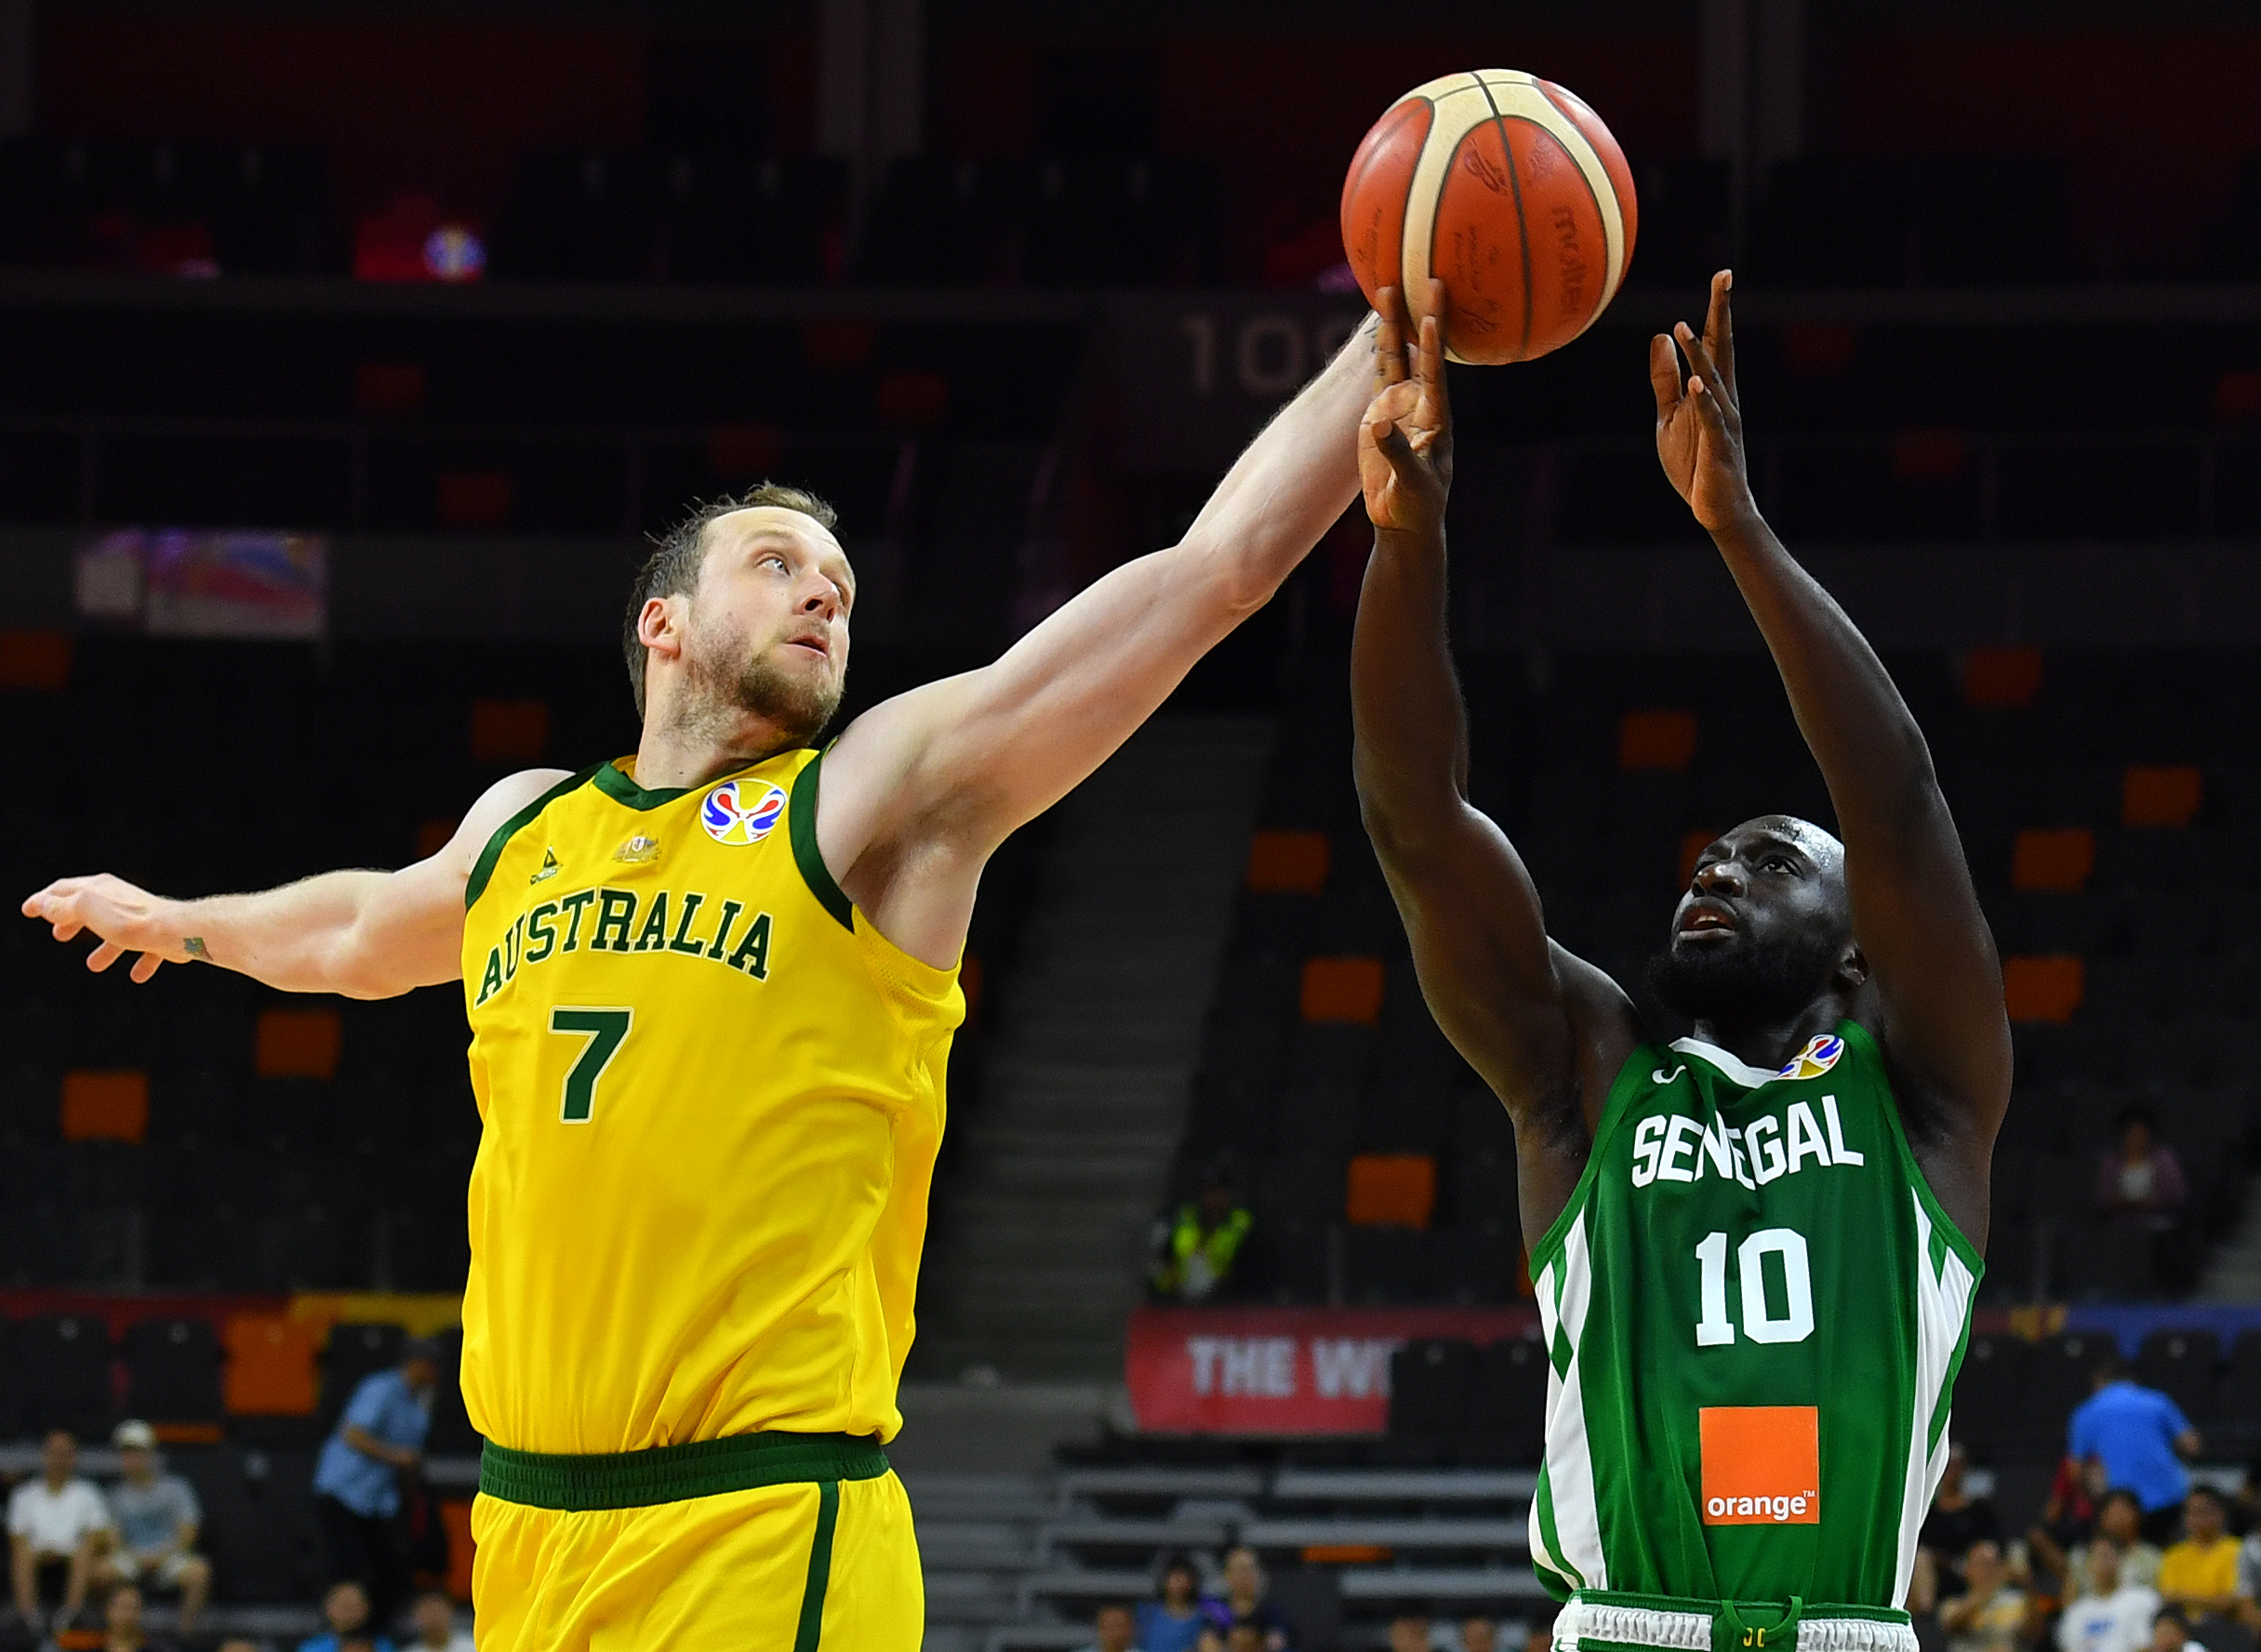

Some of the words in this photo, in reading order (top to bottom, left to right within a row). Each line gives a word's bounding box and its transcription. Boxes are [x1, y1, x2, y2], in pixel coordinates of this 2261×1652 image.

[473, 885, 773, 1010] AUSTRALIA
[547, 1006, 634, 1125] 7
[1632, 1095, 1864, 1190] SENEGAL
[1696, 1228, 1815, 1346] 10
[1185, 1335, 1298, 1398] THE
